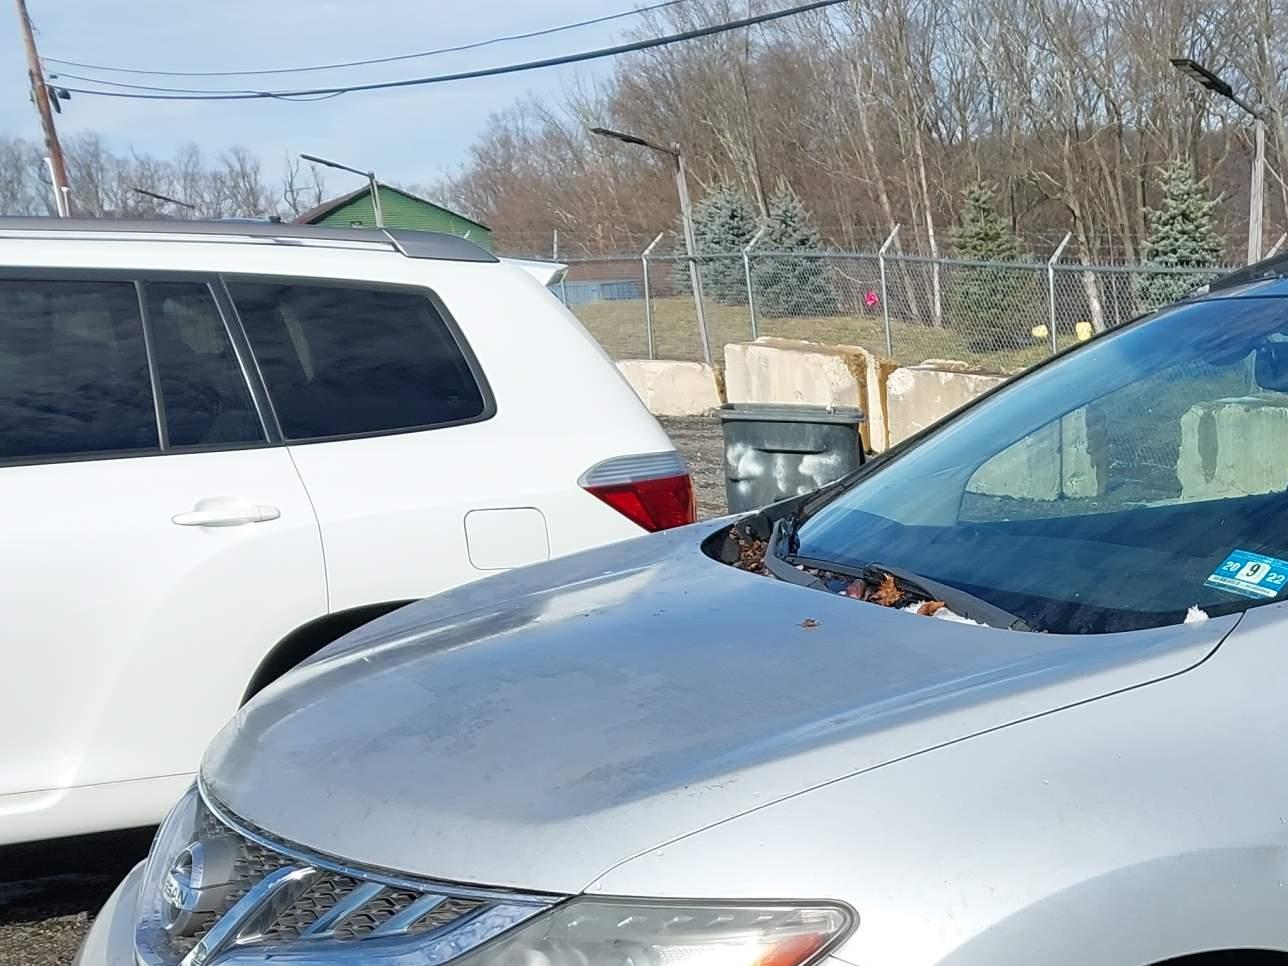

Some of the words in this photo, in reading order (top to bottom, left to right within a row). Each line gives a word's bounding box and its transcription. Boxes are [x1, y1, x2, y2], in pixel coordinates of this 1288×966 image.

[1221, 560, 1241, 572] 20
[1246, 563, 1262, 578] 9
[1265, 572, 1286, 585] 22
